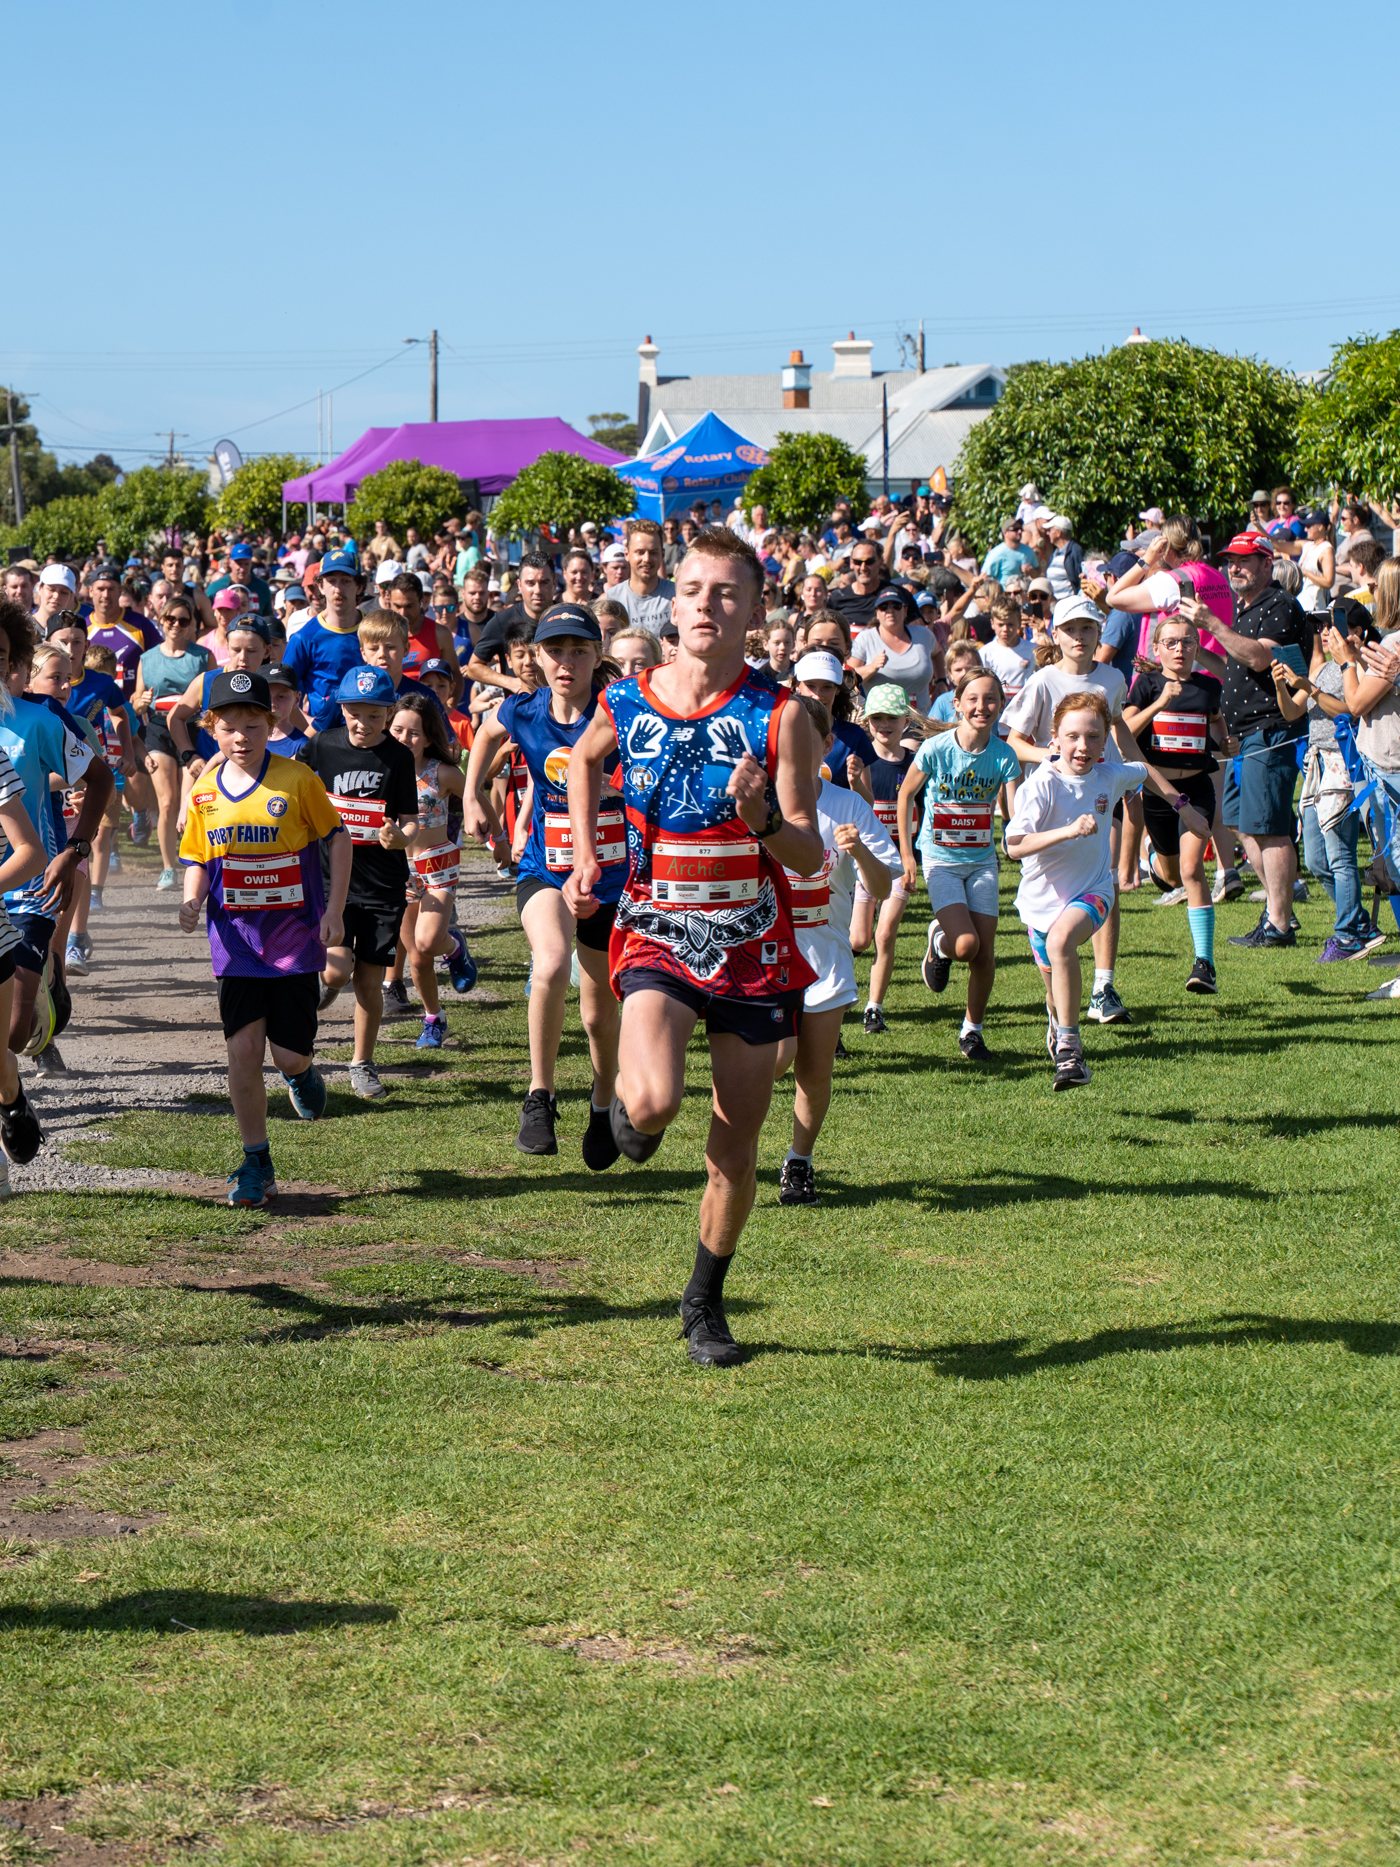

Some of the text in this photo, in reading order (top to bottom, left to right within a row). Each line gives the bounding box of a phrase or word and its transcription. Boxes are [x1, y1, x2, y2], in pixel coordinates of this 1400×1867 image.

[684, 452, 732, 464] Rotary
[684, 472, 748, 488] Rotary Club
[1200, 592, 1230, 600] VOLUNTEER
[333, 770, 384, 795] NIKE
[196, 794, 213, 803] coles
[207, 824, 280, 847] PORT FAIRY
[425, 854, 454, 874] AVA
[667, 858, 726, 877] Archie
[244, 874, 278, 884] OWEN
